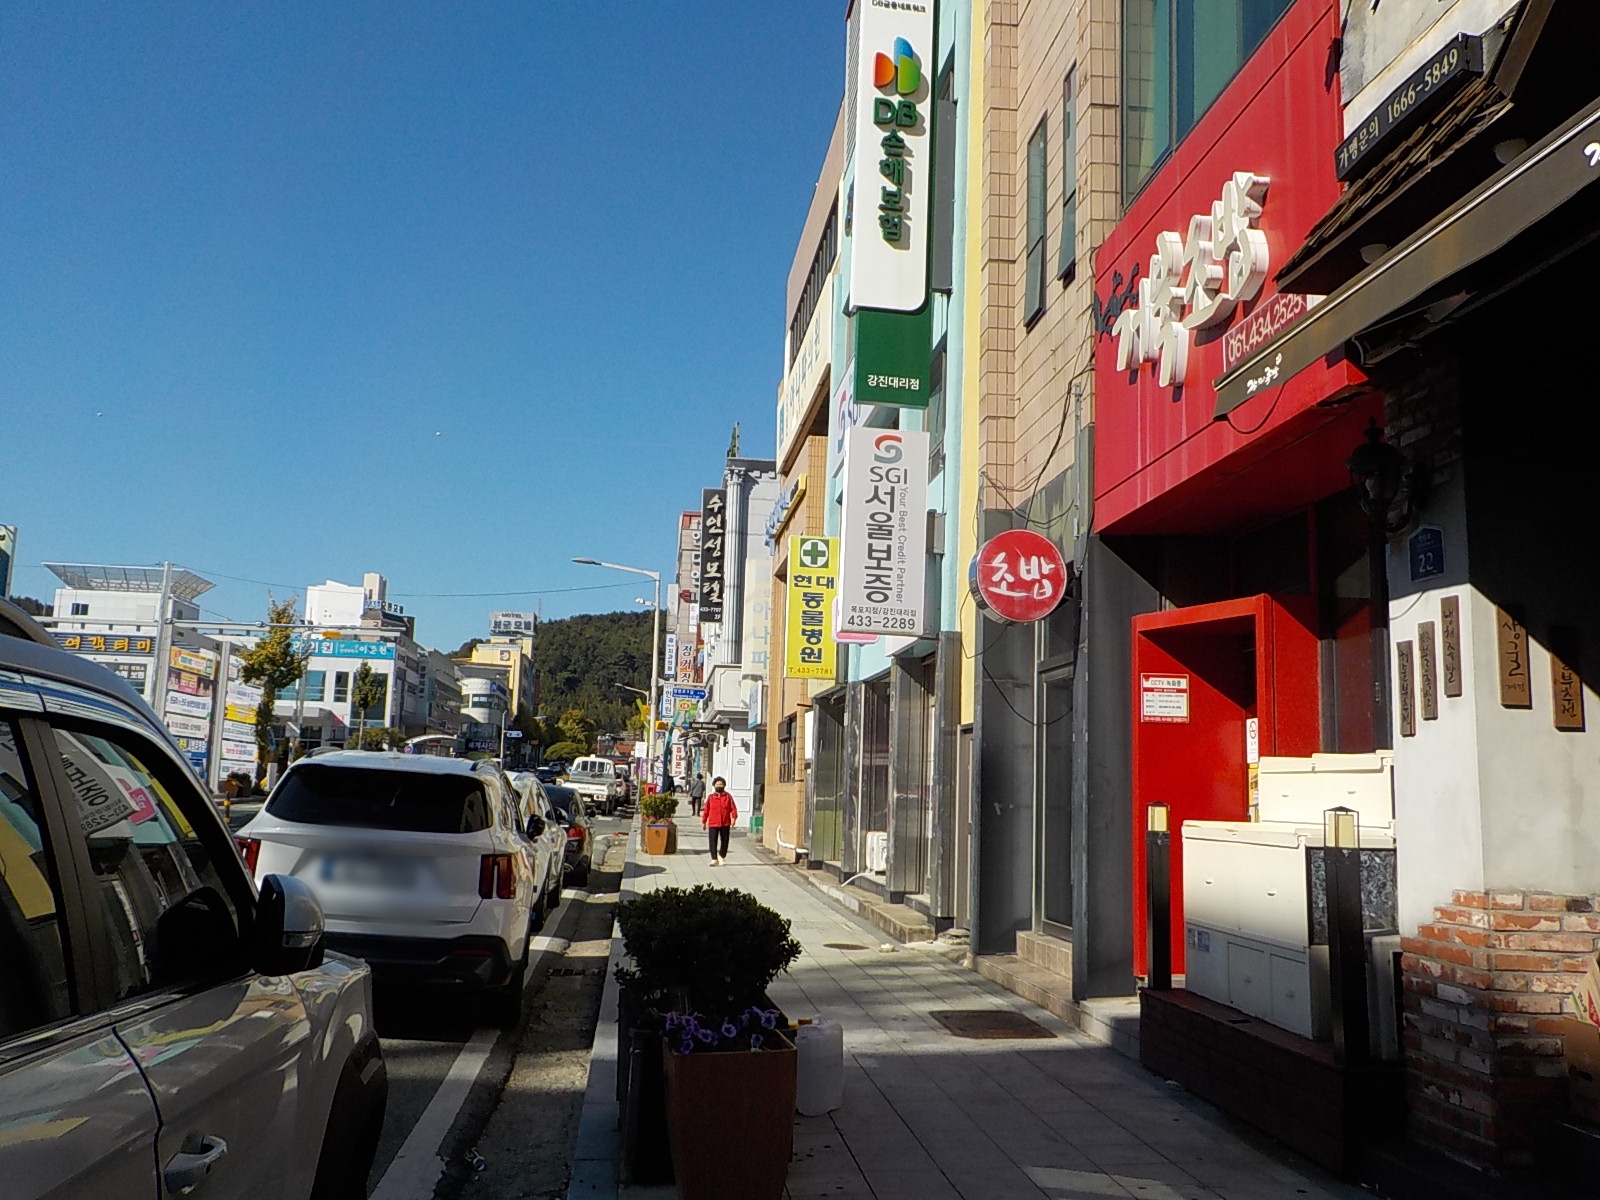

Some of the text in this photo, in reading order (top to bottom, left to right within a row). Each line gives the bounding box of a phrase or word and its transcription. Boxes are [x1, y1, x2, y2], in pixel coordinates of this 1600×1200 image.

[873, 97, 918, 127] DB
[1338, 48, 1458, 169] 가맹문의 1666-5849
[878, 128, 905, 241] 손해보험
[867, 374, 920, 390] 강진대리점
[869, 466, 908, 485] SGI
[863, 485, 895, 604] 서울보증
[896, 487, 908, 604] Your Best Credit Partner
[1418, 552, 1435, 574] 22
[793, 575, 835, 590] 현대
[800, 592, 824, 664] 동물병원
[847, 615, 916, 630] 433-2289
[789, 667, 833, 675] T.433-7781
